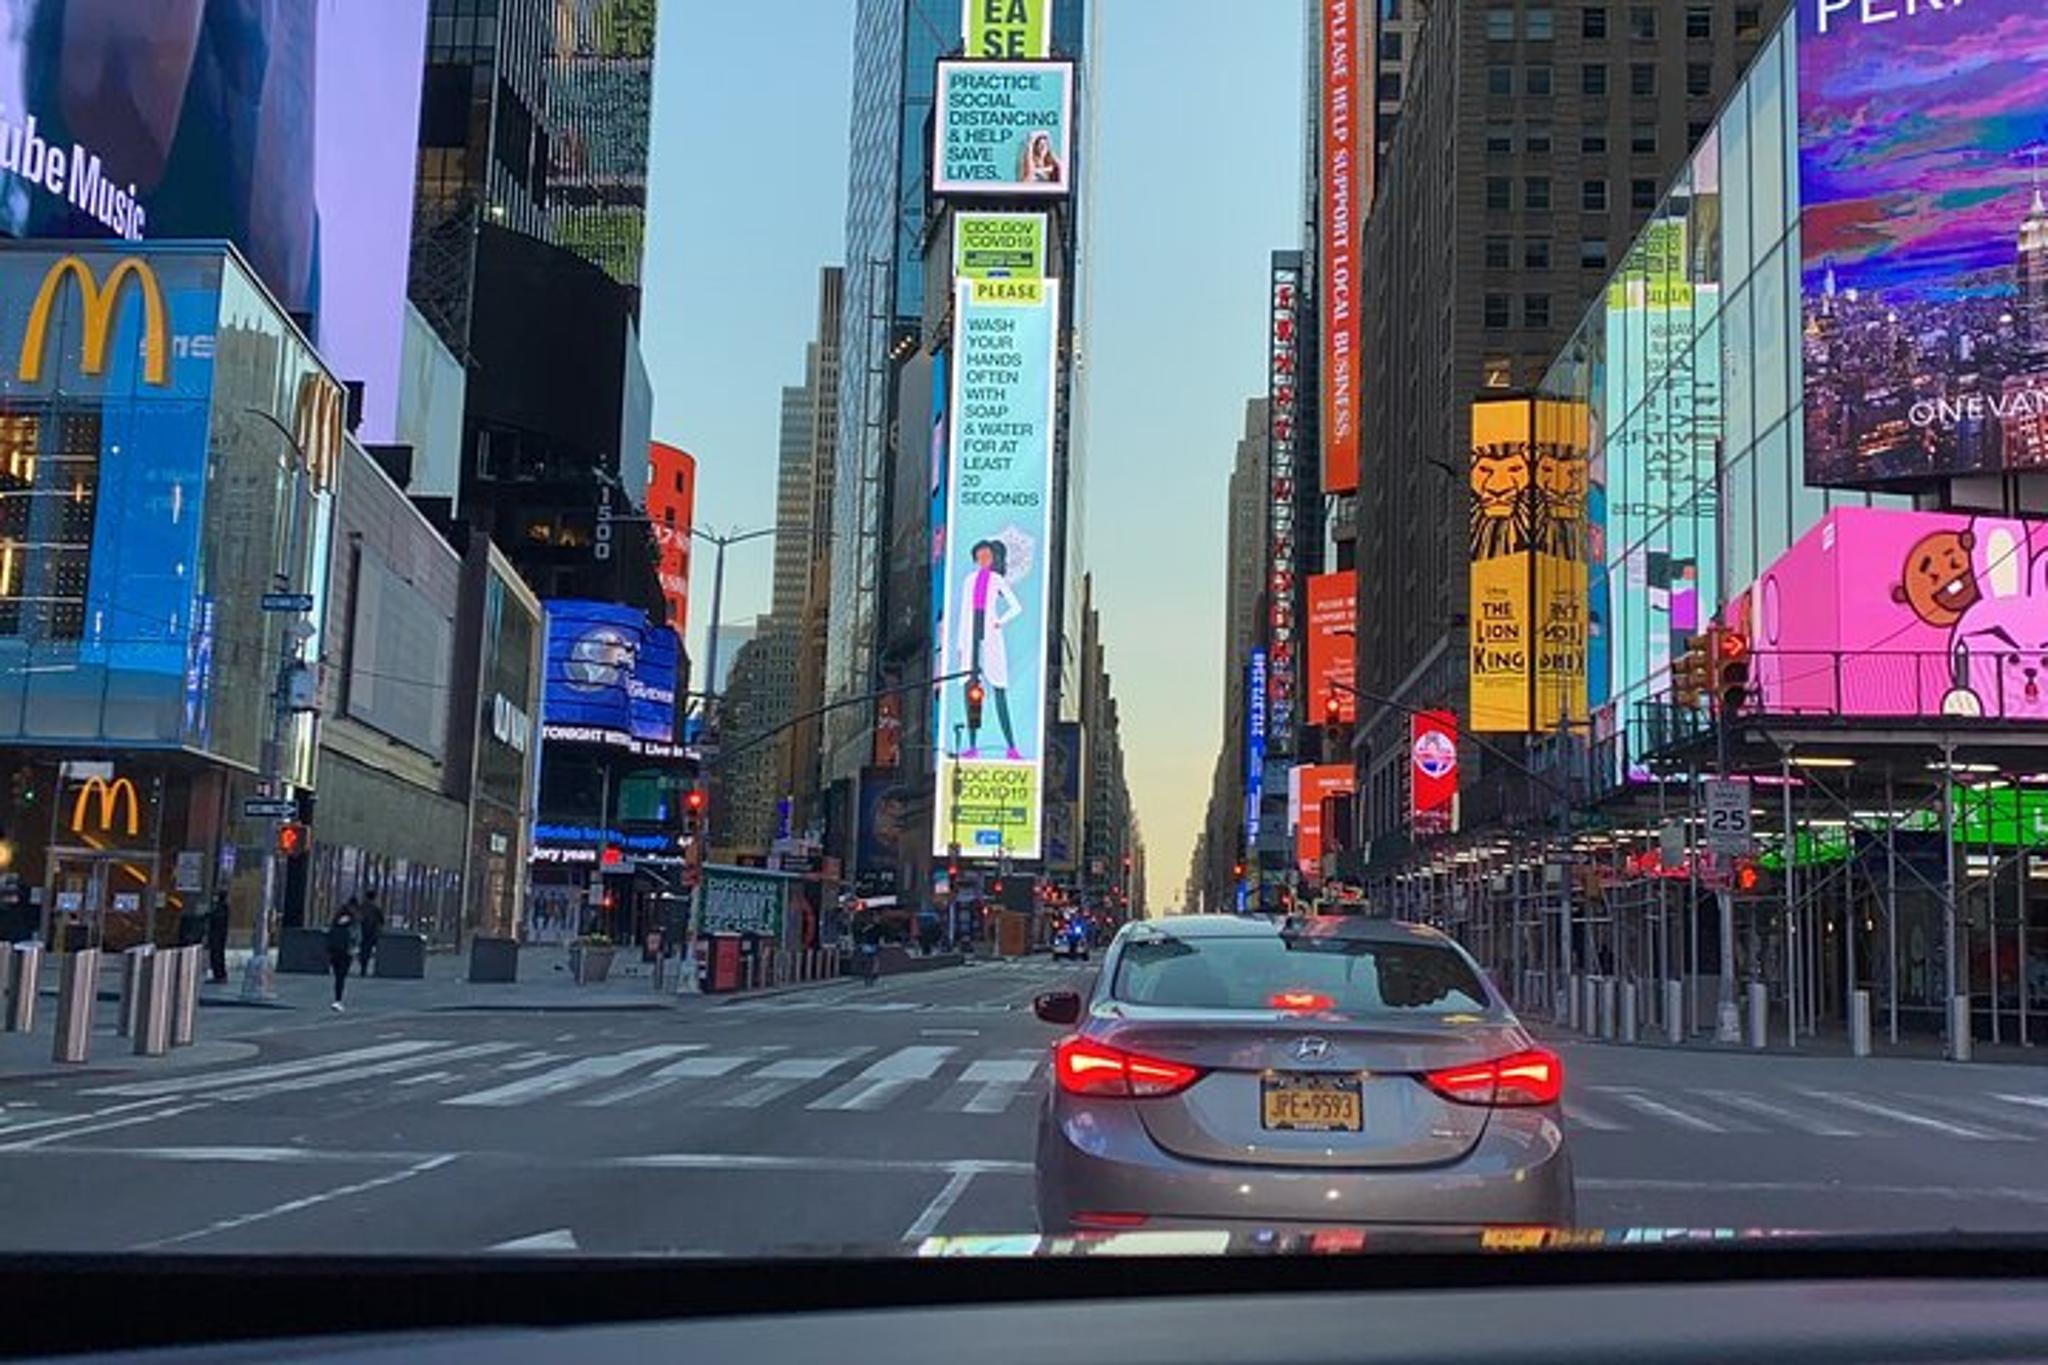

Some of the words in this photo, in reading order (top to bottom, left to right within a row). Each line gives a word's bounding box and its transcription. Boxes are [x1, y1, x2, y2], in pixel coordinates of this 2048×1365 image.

[984, 0, 1027, 24] EA
[984, 29, 1025, 58] SE
[951, 74, 1041, 91] PRACTICE
[950, 93, 1016, 108] SOCIAL
[949, 111, 1058, 126] DISTANCING
[1333, 86, 1347, 142] HELP
[949, 129, 960, 143] &
[965, 129, 1013, 143] HELP
[948, 147, 993, 162] SAVE
[947, 164, 1001, 180] LIVES.
[68, 144, 146, 241] Music
[1334, 148, 1348, 248] SUPPORT
[964, 222, 1034, 234] CDC.GOV
[977, 284, 1036, 299] PLEASE
[1333, 256, 1348, 326] LOCAL
[967, 318, 1015, 333] WASH
[967, 335, 1013, 349] YOUR
[966, 353, 1022, 367] HANDS
[966, 370, 1019, 384] OFTEN
[965, 387, 1005, 400] WITH
[964, 404, 1009, 418] SOAP
[964, 422, 974, 436] &
[978, 423, 1034, 436] WATER
[963, 440, 996, 453] FOR
[1000, 440, 1019, 453] AT
[963, 457, 1013, 470] LEAST
[961, 474, 981, 488] 20
[961, 491, 1040, 507] SECONDS
[1482, 602, 1512, 616] THE
[1476, 620, 1519, 644] LION
[1473, 647, 1526, 675] KING
[1712, 810, 1745, 831] 25
